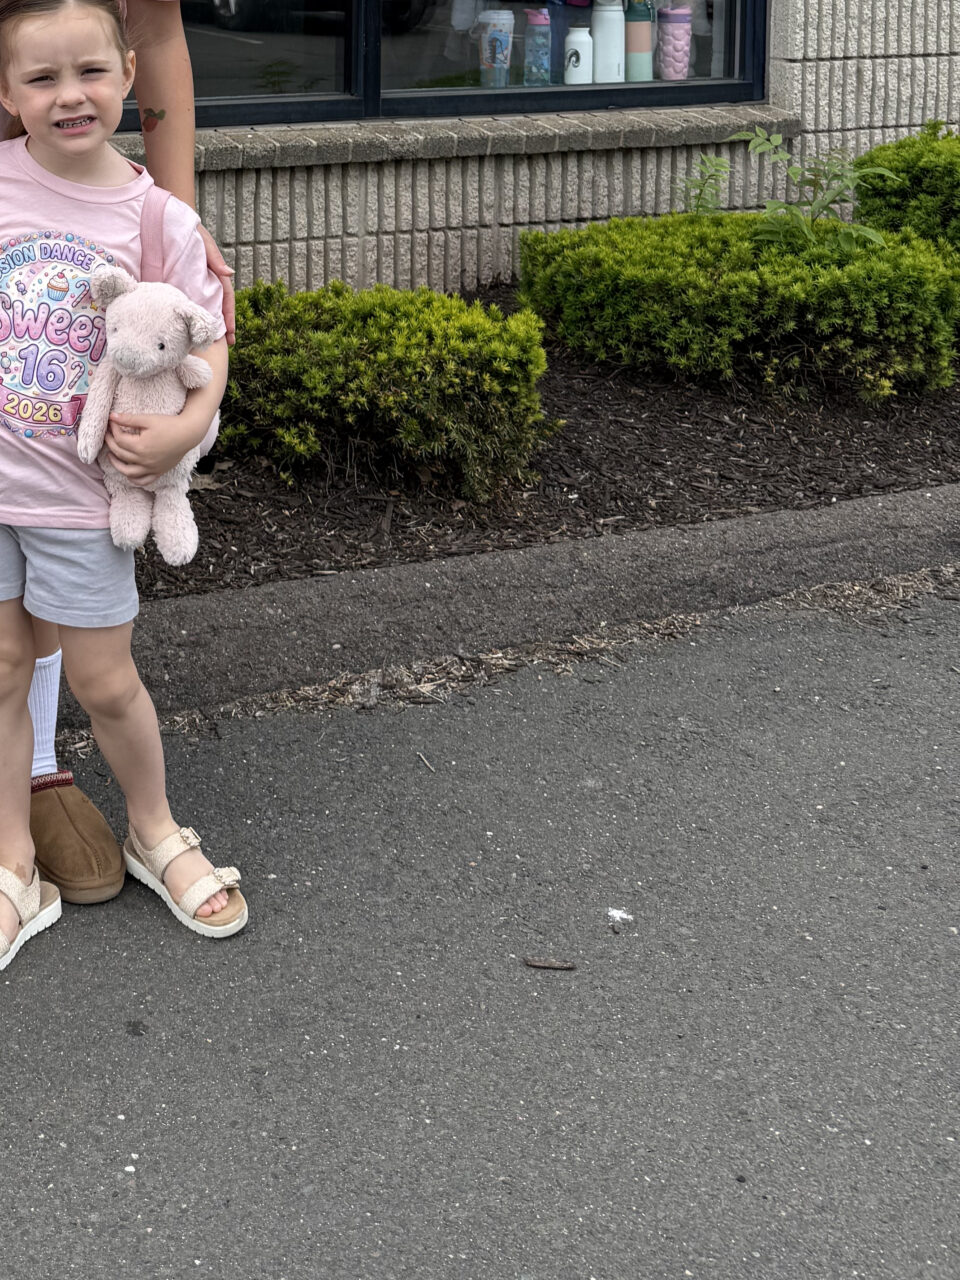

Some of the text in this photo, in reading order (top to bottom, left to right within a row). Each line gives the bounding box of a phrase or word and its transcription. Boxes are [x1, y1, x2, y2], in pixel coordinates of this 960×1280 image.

[40, 243, 95, 269] DANCE
[19, 343, 68, 391] 16
[3, 394, 63, 422] 2026
